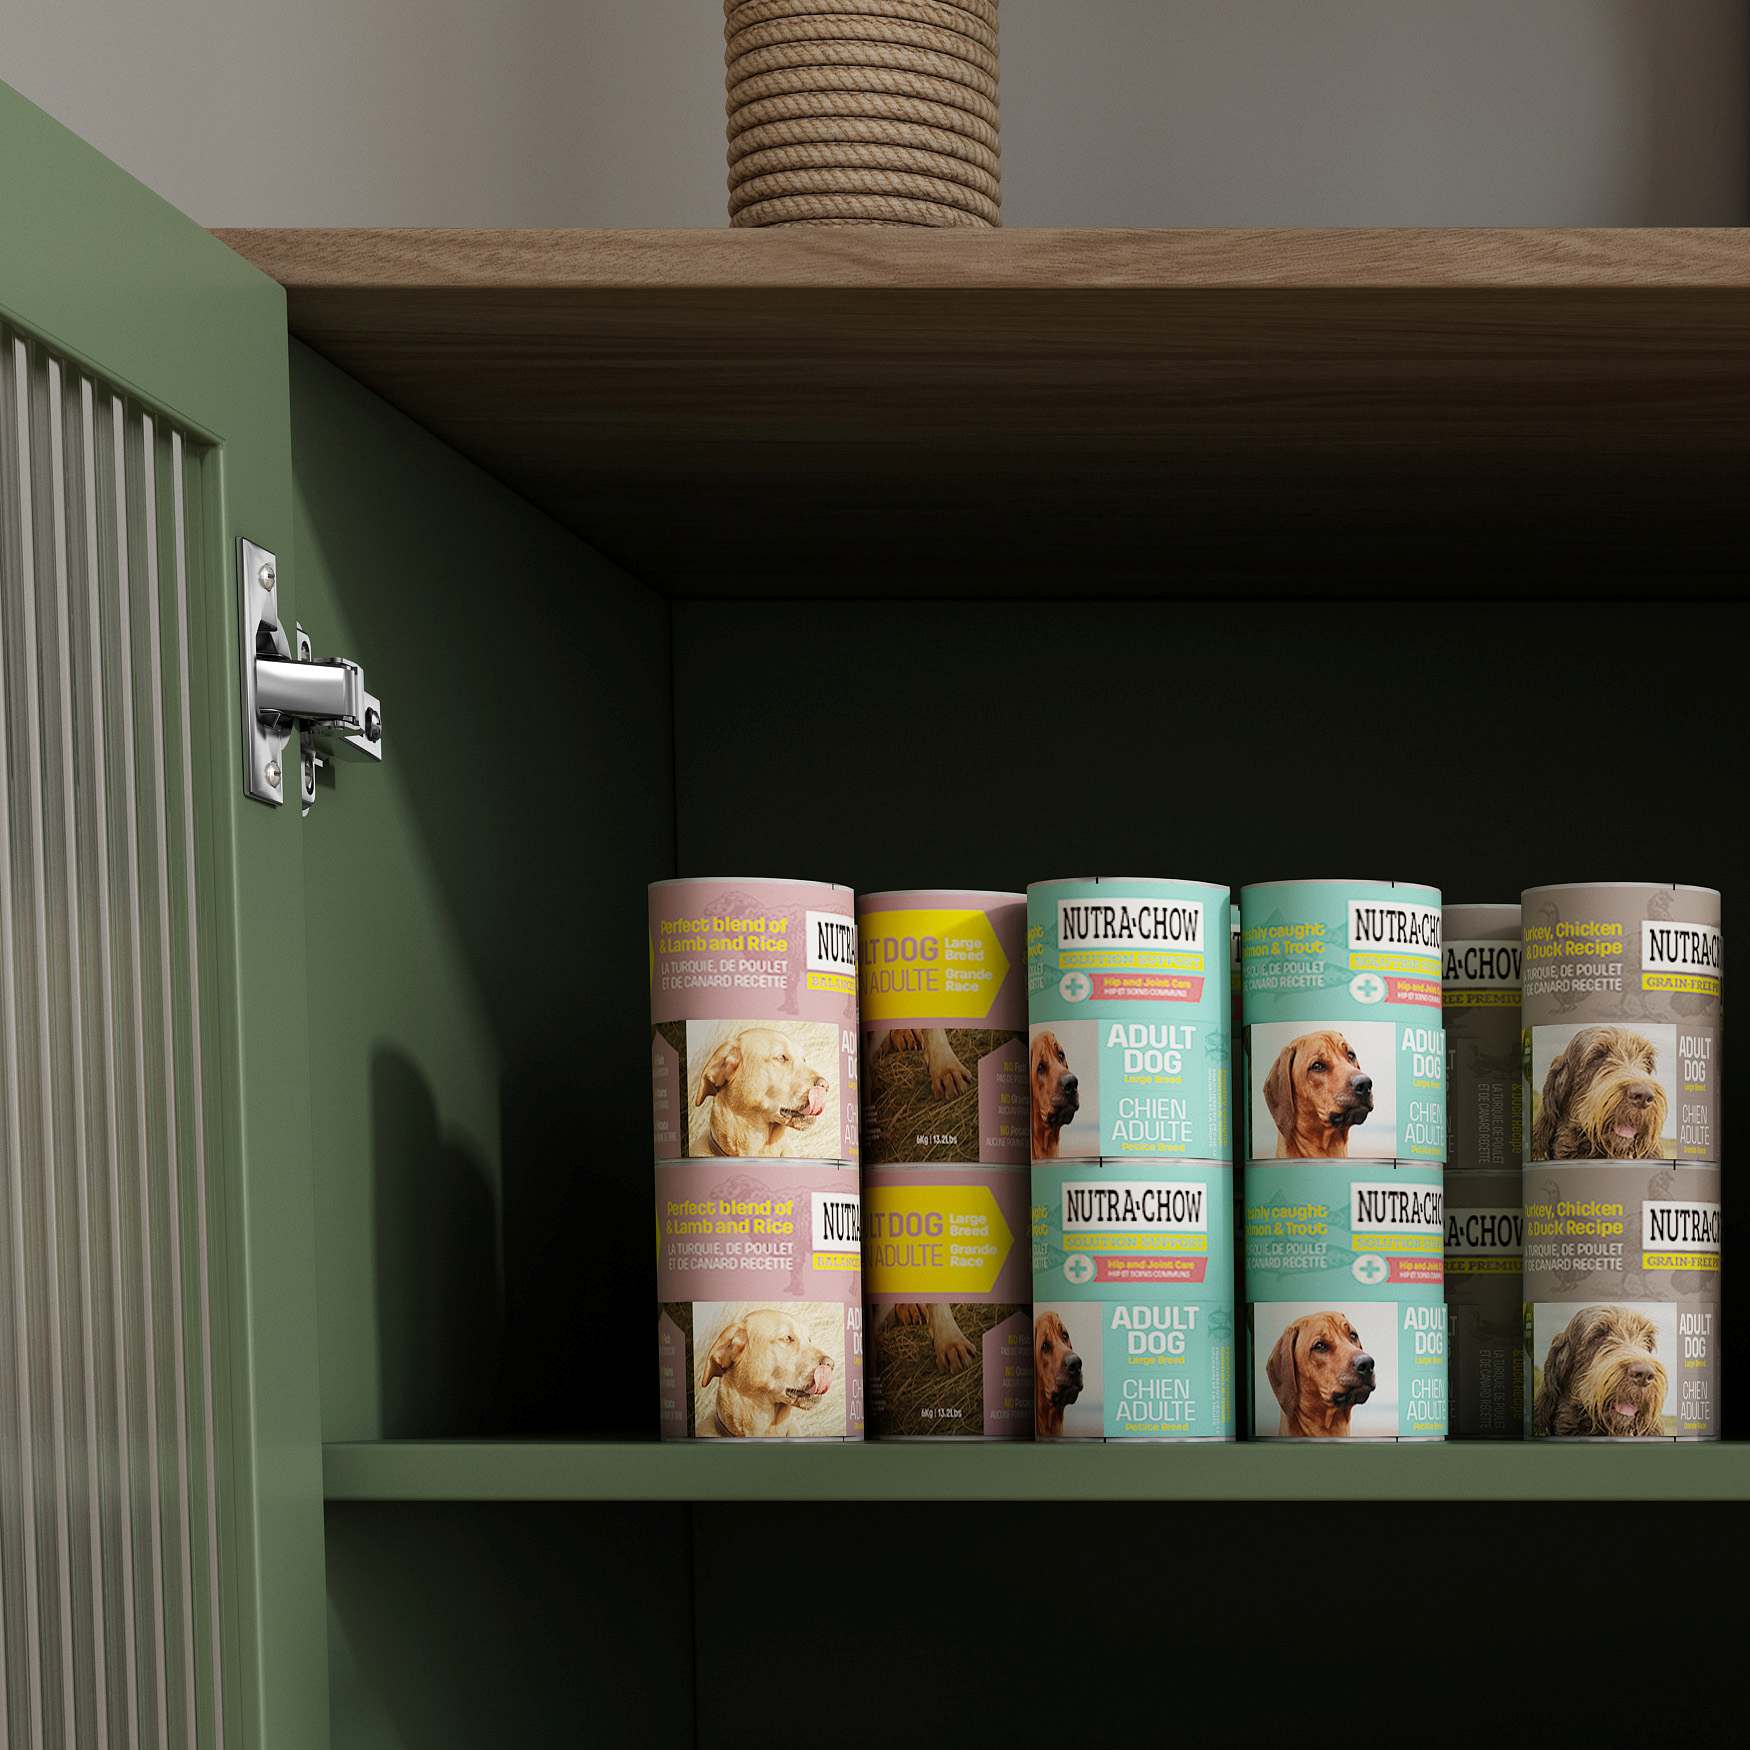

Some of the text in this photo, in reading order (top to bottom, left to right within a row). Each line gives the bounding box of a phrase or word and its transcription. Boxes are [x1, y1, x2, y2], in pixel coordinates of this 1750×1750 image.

[660, 916, 789, 935] Perfect blend of
[1269, 923, 1325, 939] caught
[1556, 921, 1623, 938] Chicken
[668, 936, 707, 953] Lamb
[709, 936, 744, 951] and
[747, 936, 788, 952] Rice
[883, 936, 939, 963] DOG
[944, 937, 982, 950] Large
[1284, 941, 1325, 955] Trout
[1566, 940, 1623, 957] Recipe
[1283, 961, 1325, 974] POULET
[1560, 963, 1623, 977] DE POULET
[872, 969, 940, 992] ADULTE
[1572, 978, 1623, 991] RECETTE
[1107, 1024, 1196, 1049] ADULT
[1679, 1036, 1711, 1059] ADULT
[1124, 1049, 1182, 1074] DOG
[1684, 1060, 1706, 1081] DOG
[1119, 1097, 1187, 1119] CHIEN
[1112, 1120, 1193, 1142] ADULTE
